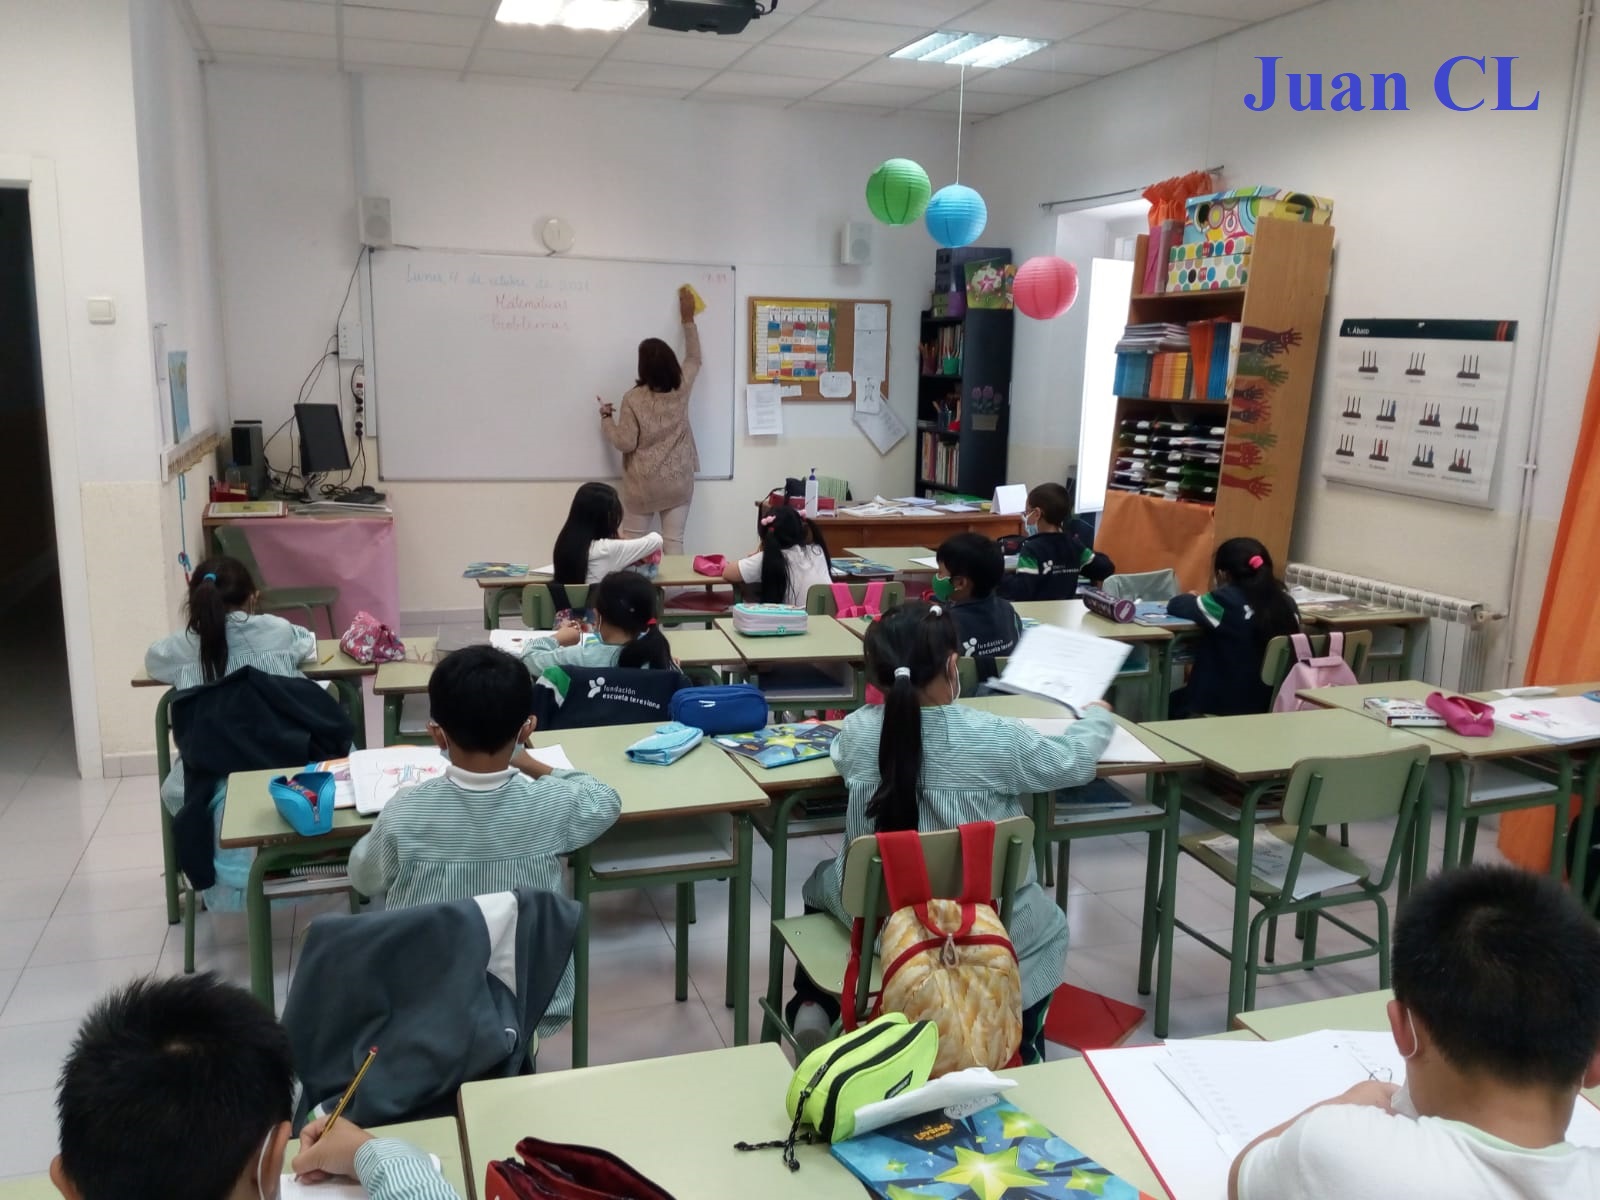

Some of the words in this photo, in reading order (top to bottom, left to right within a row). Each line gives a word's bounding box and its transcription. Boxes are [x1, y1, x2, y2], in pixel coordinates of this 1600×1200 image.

[604, 684, 636, 695] fundación
[602, 693, 629, 702] escuela
[629, 696, 660, 709] teresiana
